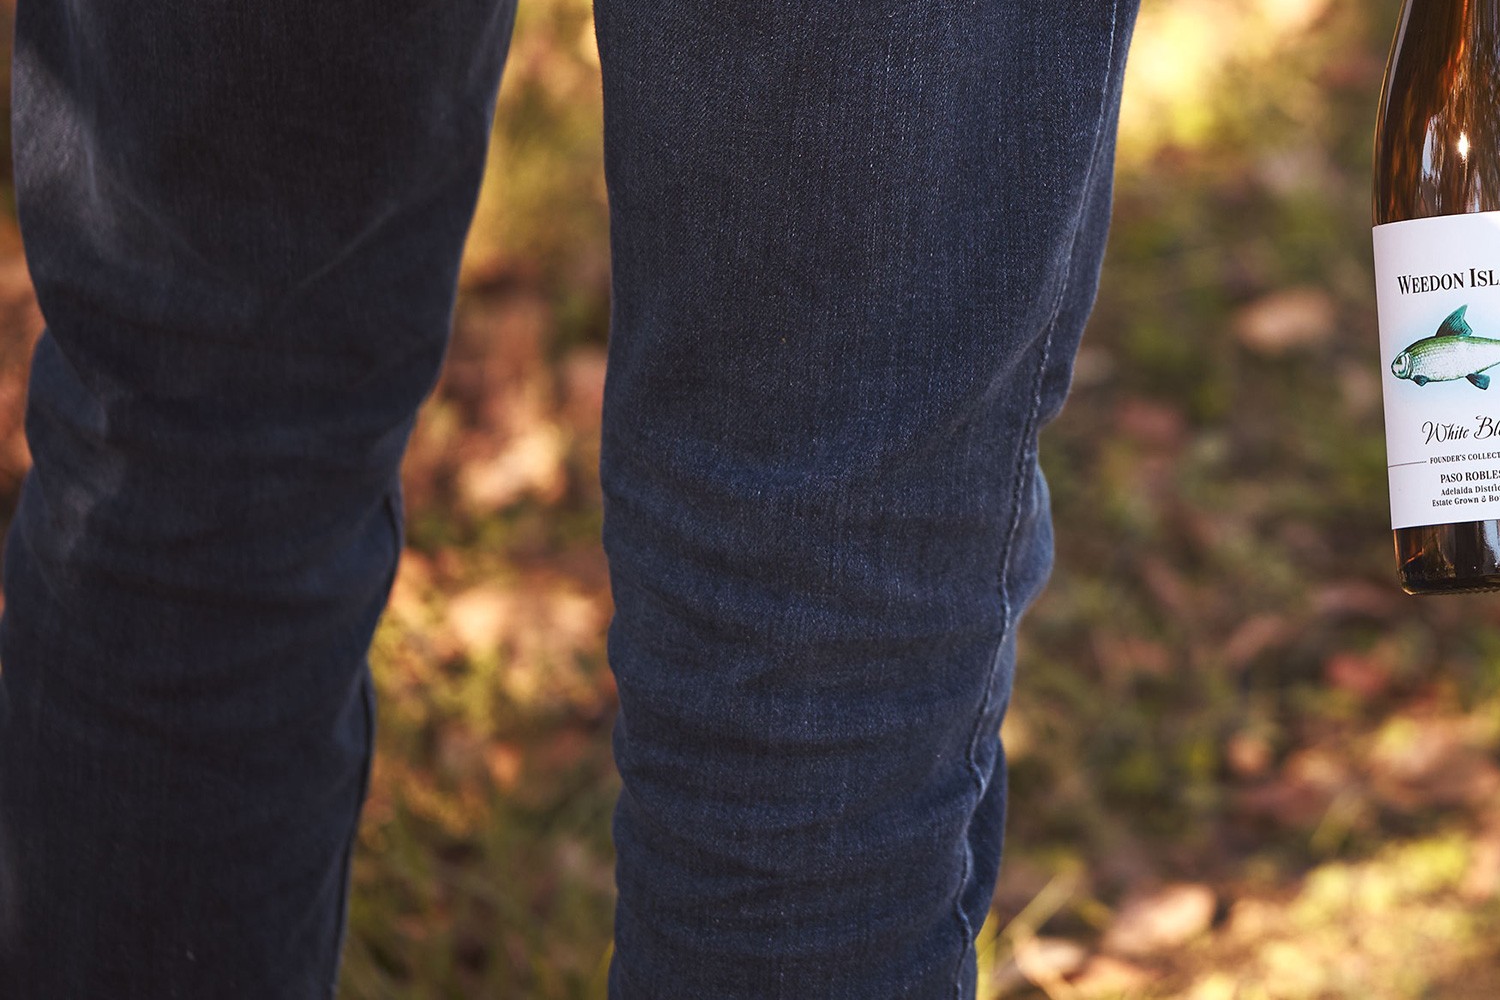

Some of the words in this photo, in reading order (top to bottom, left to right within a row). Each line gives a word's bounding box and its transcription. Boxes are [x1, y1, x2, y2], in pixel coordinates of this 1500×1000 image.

[1397, 271, 1465, 295] WEEDON
[1421, 420, 1470, 445] White
[1430, 453, 1467, 465] FOUNDER'S
[1440, 472, 1463, 484] PASO
[1441, 485, 1473, 496] Adelaida
[1432, 498, 1453, 507] Estate
[1454, 496, 1479, 505] Grown
